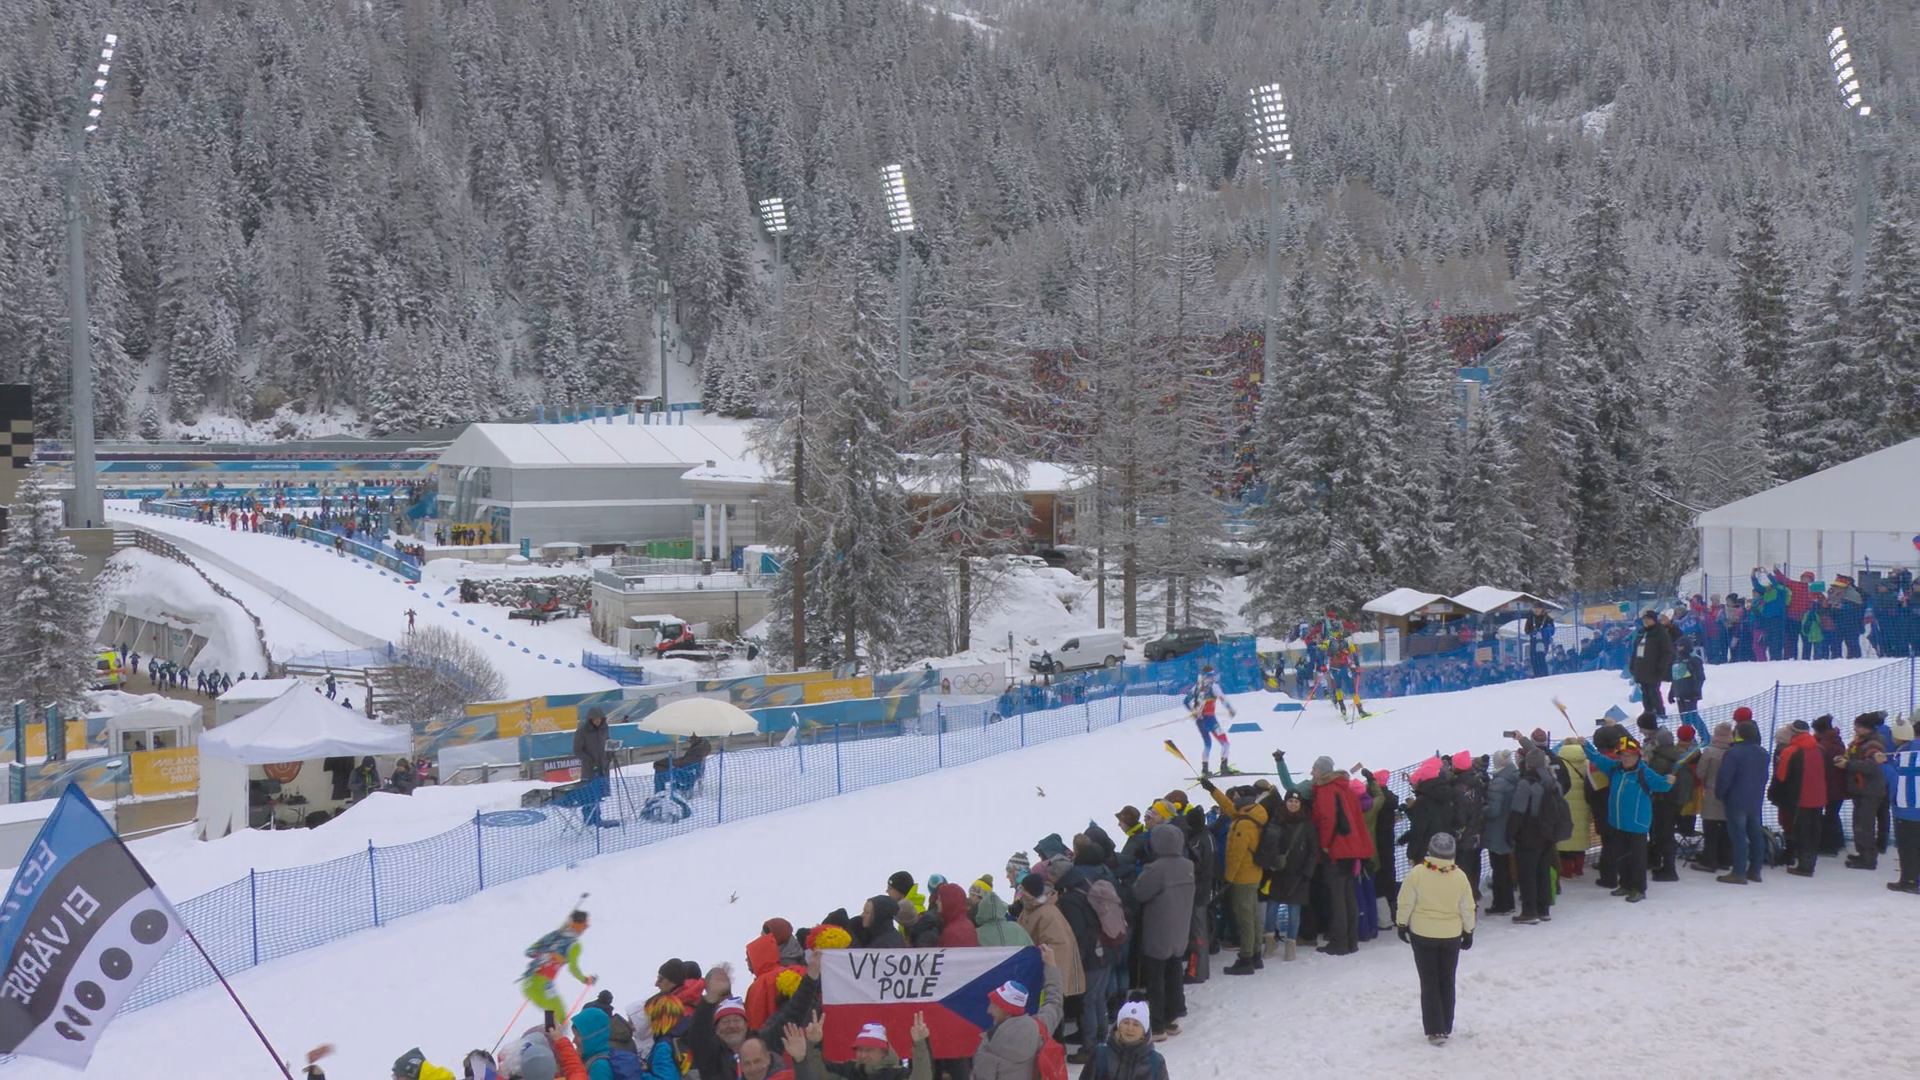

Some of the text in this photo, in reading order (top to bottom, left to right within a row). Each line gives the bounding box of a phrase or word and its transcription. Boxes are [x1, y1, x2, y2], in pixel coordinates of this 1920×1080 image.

[152, 755, 198, 768] MILANO
[160, 765, 198, 775] CORTIN
[849, 949, 946, 979] VYSOKÉ
[878, 977, 938, 1000] POLE
